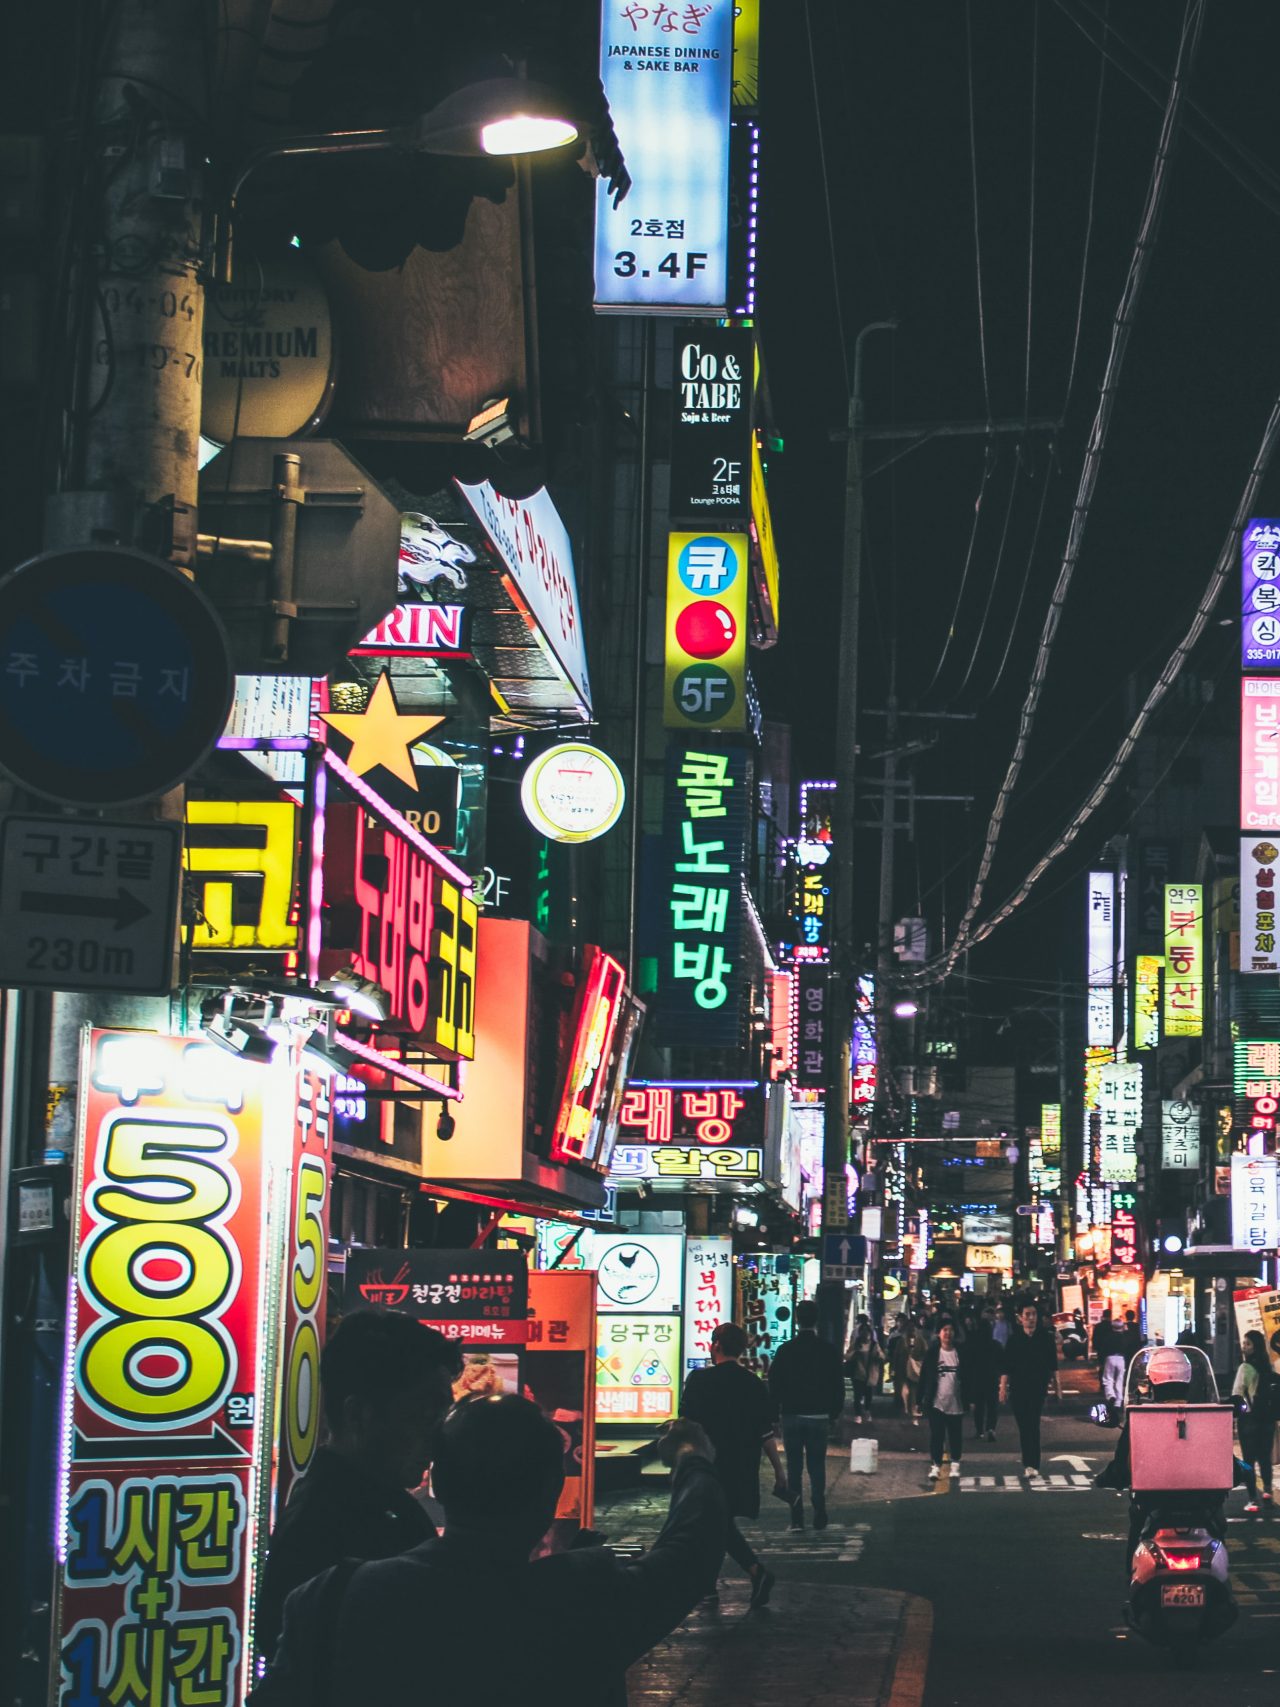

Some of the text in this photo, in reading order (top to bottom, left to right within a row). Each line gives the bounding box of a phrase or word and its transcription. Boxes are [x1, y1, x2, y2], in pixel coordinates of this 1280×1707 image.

[620, 2, 712, 34] やなぎ
[608, 45, 720, 59] JAPANESE DINING
[623, 60, 699, 72] & SAKE BAR
[631, 219, 685, 239] 2호점
[613, 251, 708, 279] 3.4F
[721, 354, 742, 381] &
[682, 382, 741, 408] TABE
[681, 413, 731, 424] Soju & Beer
[713, 458, 741, 482] 2F
[691, 497, 714, 505] Lounge
[687, 546, 727, 588] 큐
[1257, 556, 1278, 641] 킥복싱
[681, 677, 727, 712] 5F
[22, 833, 154, 881] 구간끝
[671, 751, 733, 1010] 콜노래방
[26, 937, 135, 977] 230m
[1169, 910, 1198, 1009] 부동산
[1113, 1210, 1136, 1264] 노래방
[611, 1325, 673, 1343] 당구장
[70, 1489, 235, 1574] 1시간
[64, 1624, 229, 1707] 1시간
